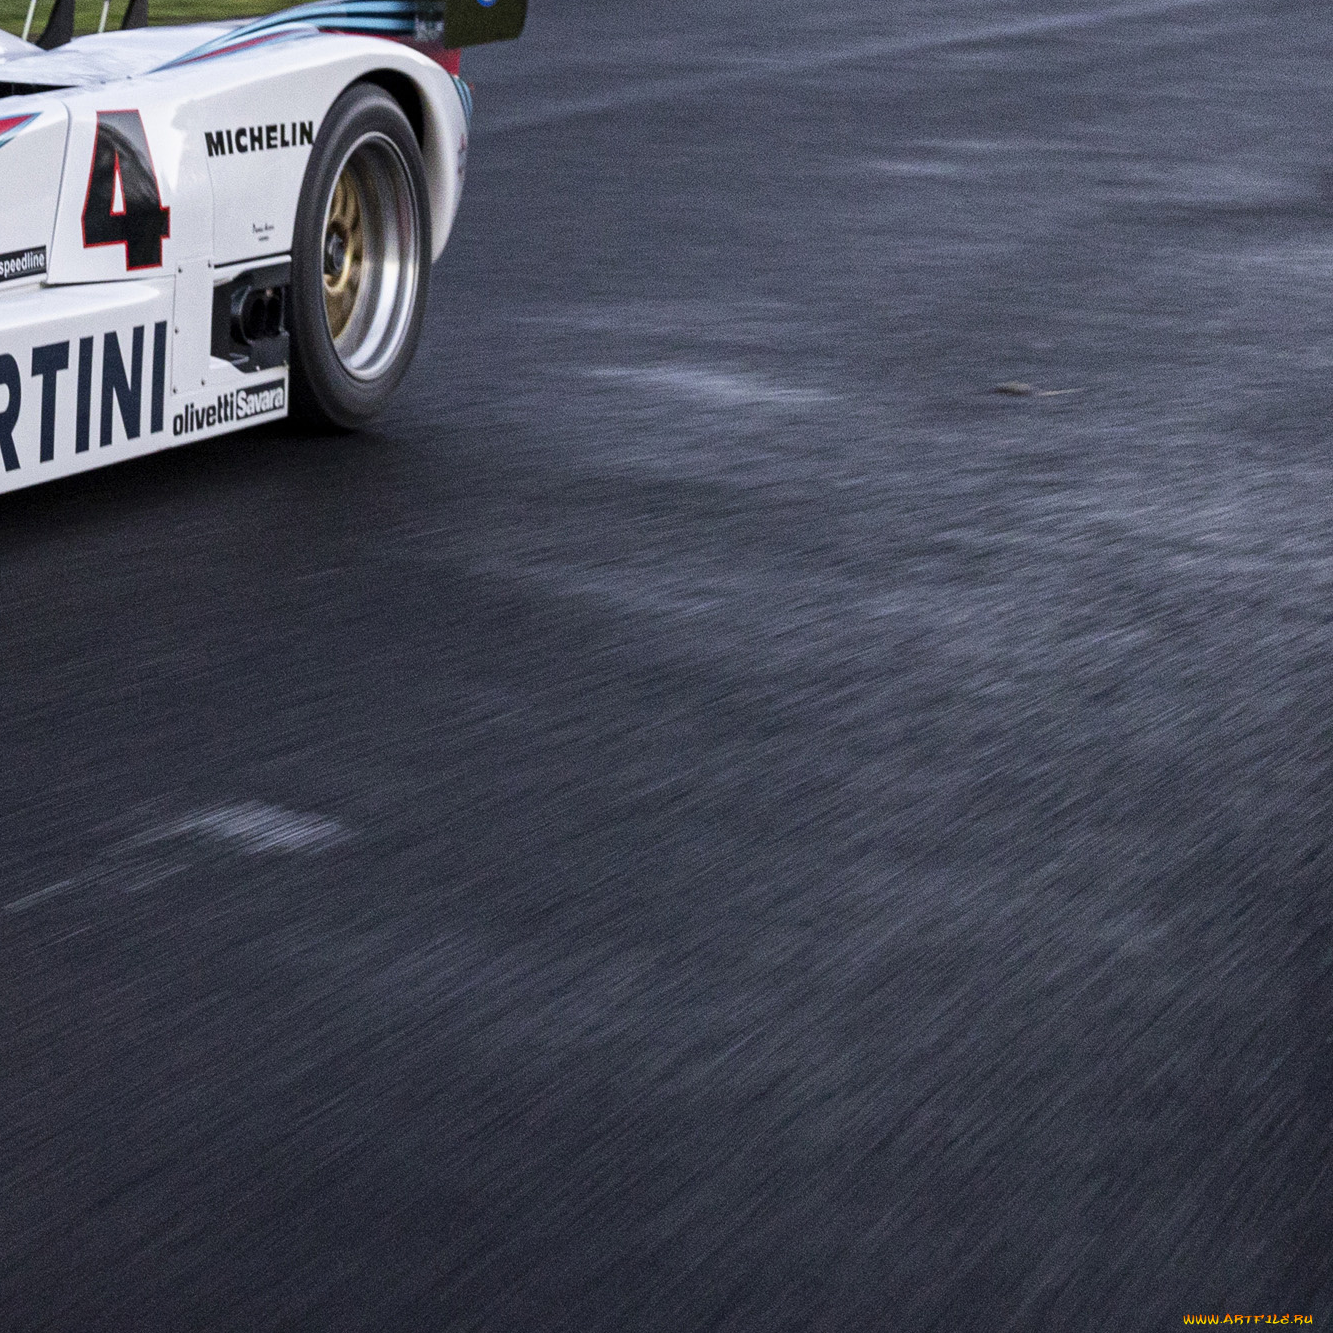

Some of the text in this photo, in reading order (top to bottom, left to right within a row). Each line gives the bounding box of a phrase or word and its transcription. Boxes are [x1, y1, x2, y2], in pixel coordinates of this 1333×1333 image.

[204, 120, 313, 157] MICHELIN
[81, 109, 171, 271] 4
[173, 391, 235, 436] olivetti
